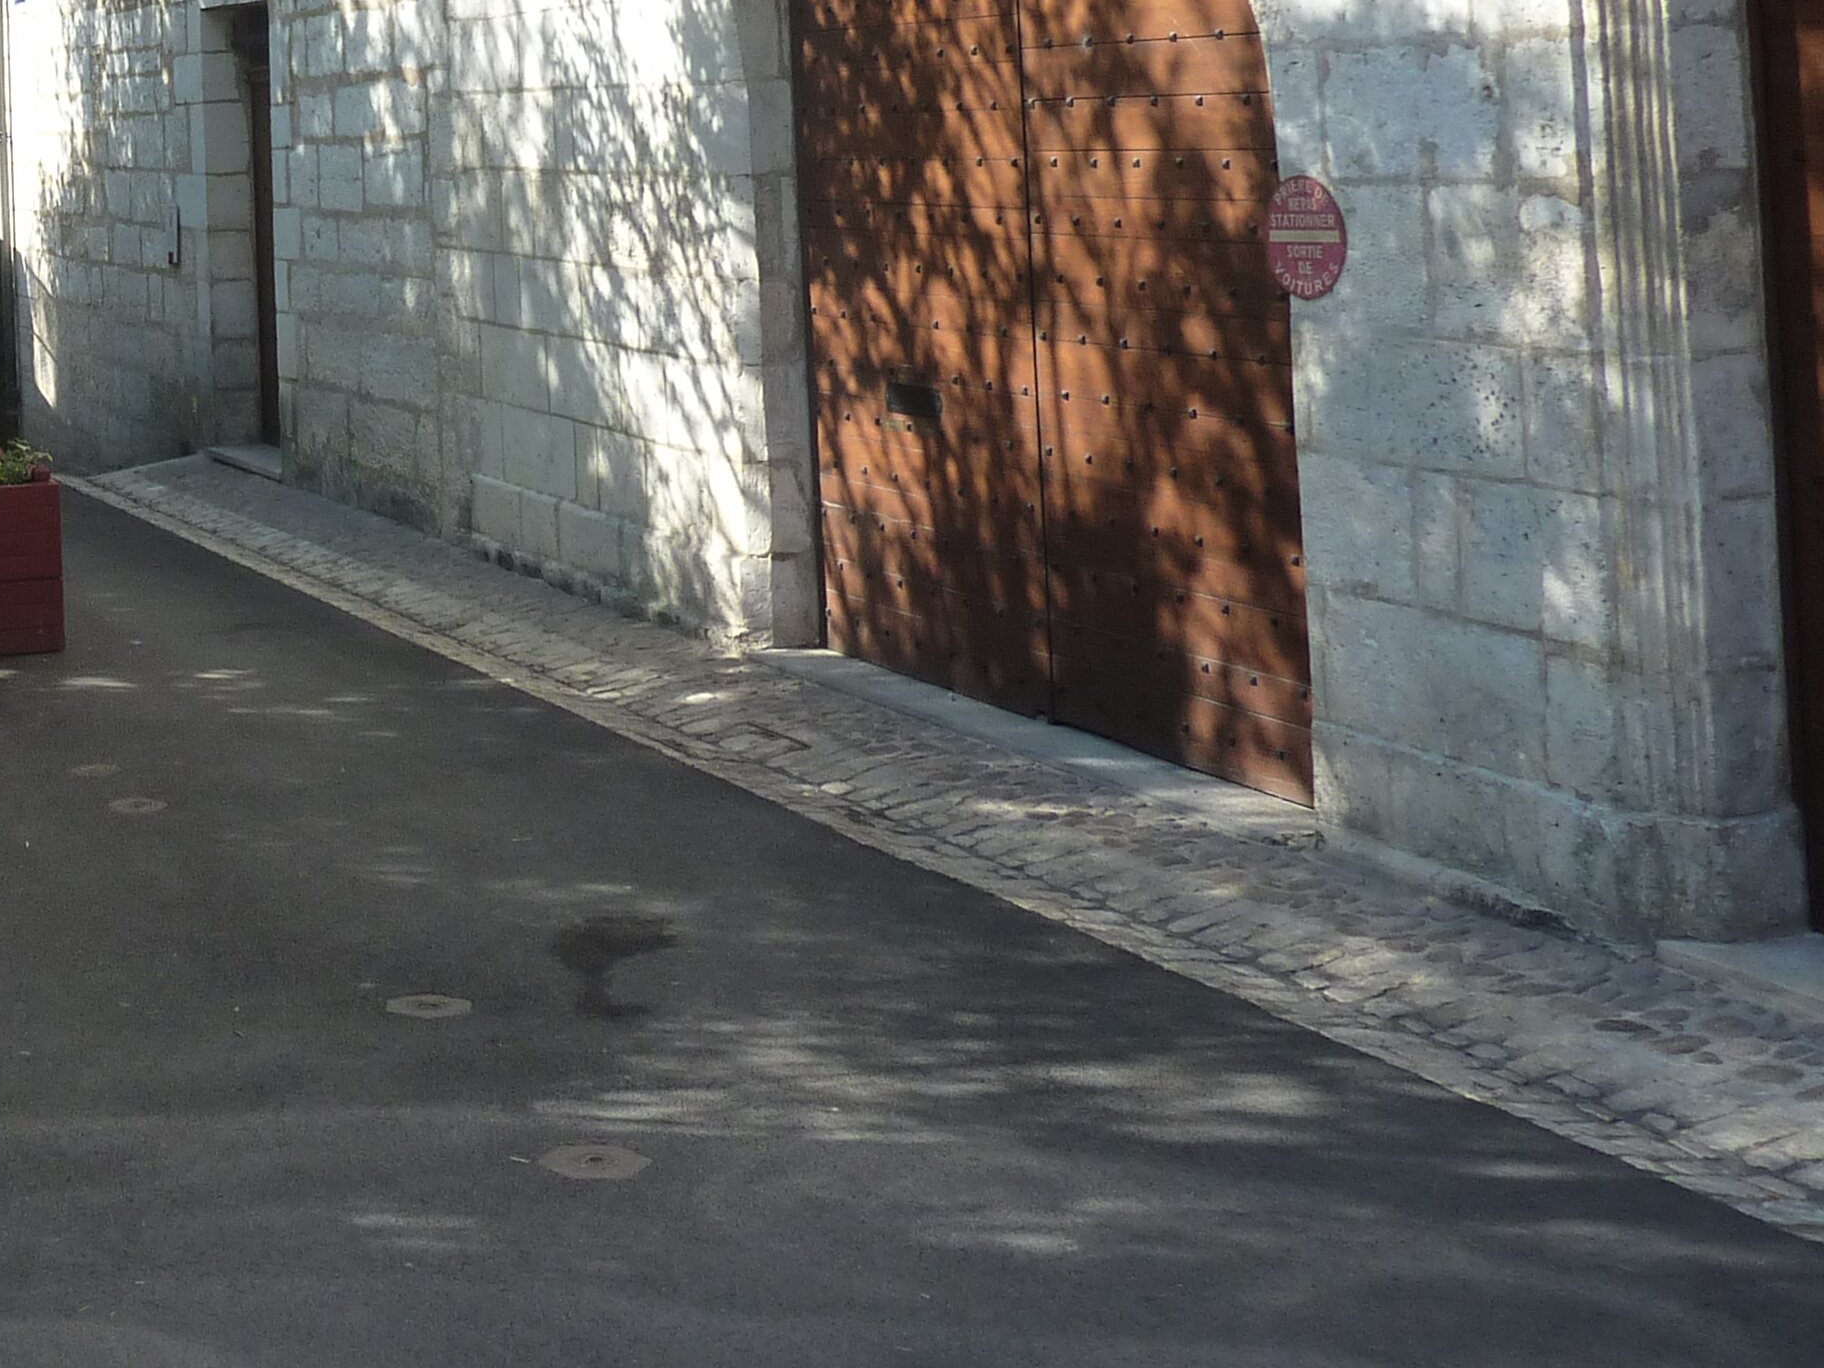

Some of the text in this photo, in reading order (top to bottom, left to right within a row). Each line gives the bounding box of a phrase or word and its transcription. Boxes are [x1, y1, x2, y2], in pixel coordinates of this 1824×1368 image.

[1288, 197, 1317, 211] NE PAS
[1314, 189, 1329, 205] DE
[1270, 214, 1335, 227] STATIONNER
[1287, 245, 1323, 259] SORTIE
[1298, 261, 1313, 274] DE
[1275, 260, 1339, 295] VOITURES
